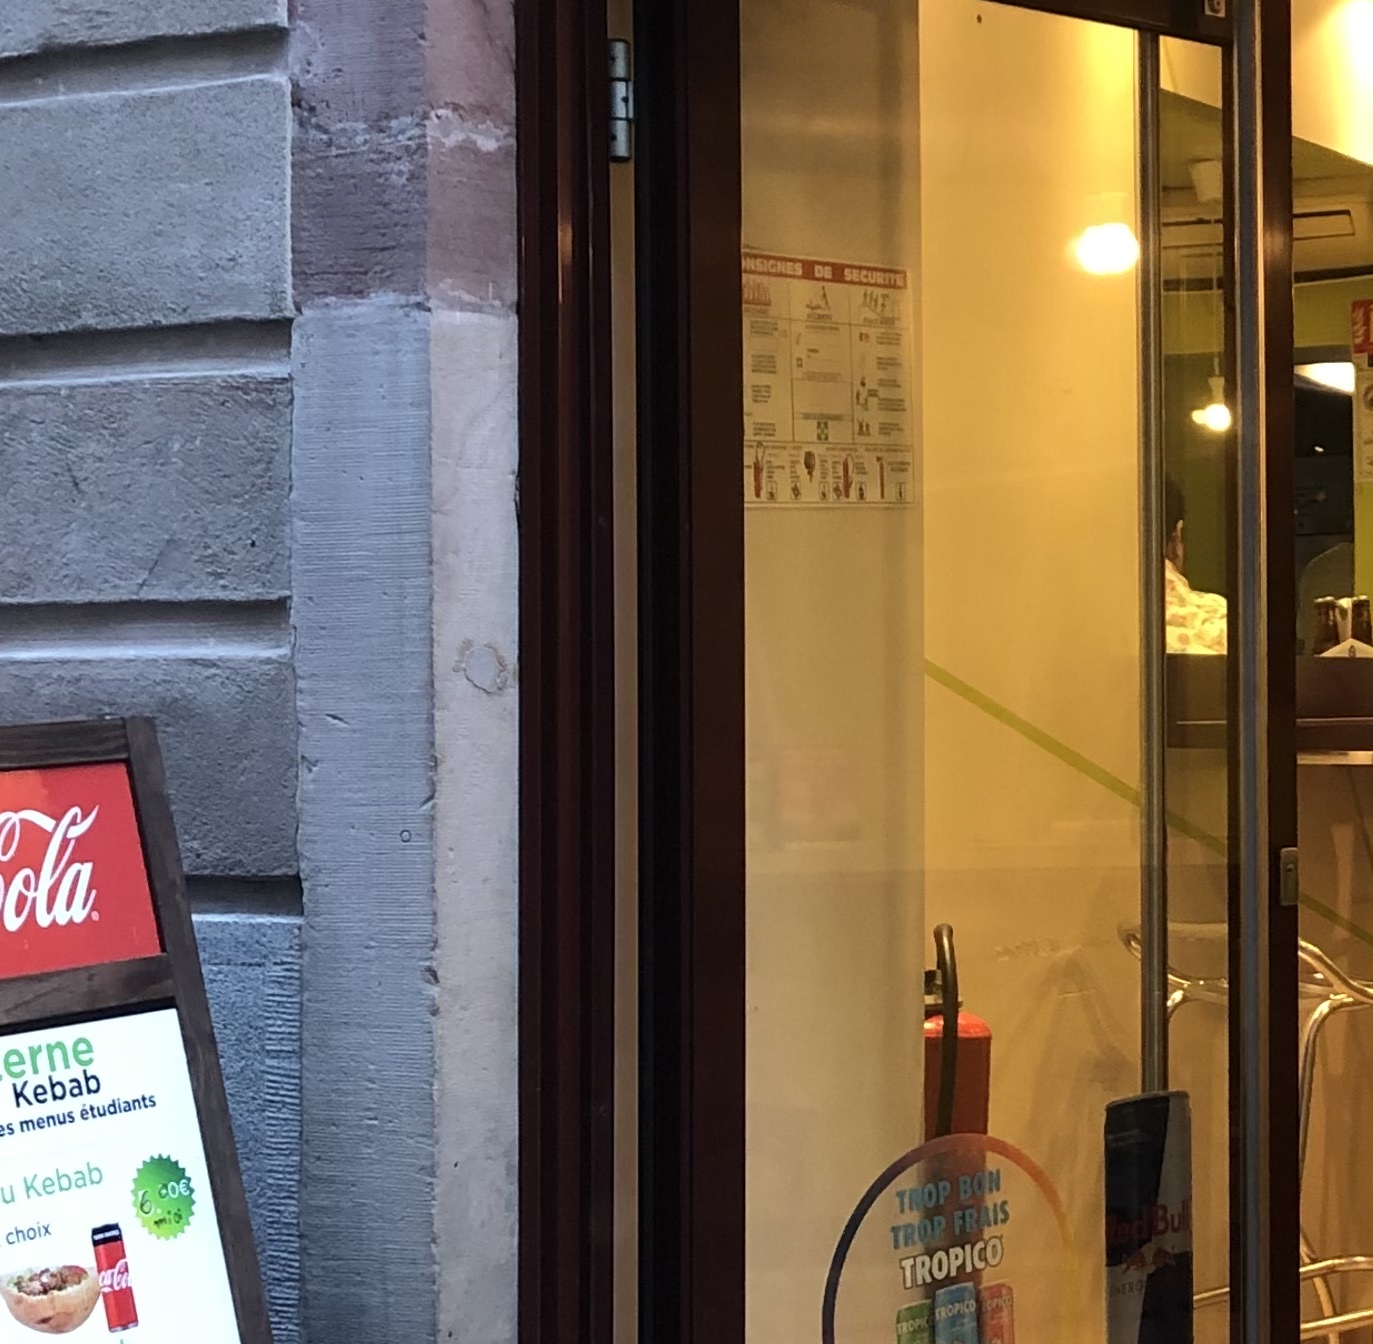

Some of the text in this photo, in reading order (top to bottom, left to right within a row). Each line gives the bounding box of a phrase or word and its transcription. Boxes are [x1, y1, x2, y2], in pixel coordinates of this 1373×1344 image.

[814, 264, 832, 279] DE
[0, 1037, 94, 1081] erne
[12, 1069, 101, 1108] Kebab
[19, 1110, 75, 1133] menus
[80, 1094, 156, 1121] étudiants
[23, 1162, 103, 1199] Kebab
[5, 1221, 52, 1245] choix
[890, 1200, 1010, 1250] TROP FRAIS
[899, 1235, 1004, 1290] TROPICO
[935, 1300, 977, 1320] TROPICO
